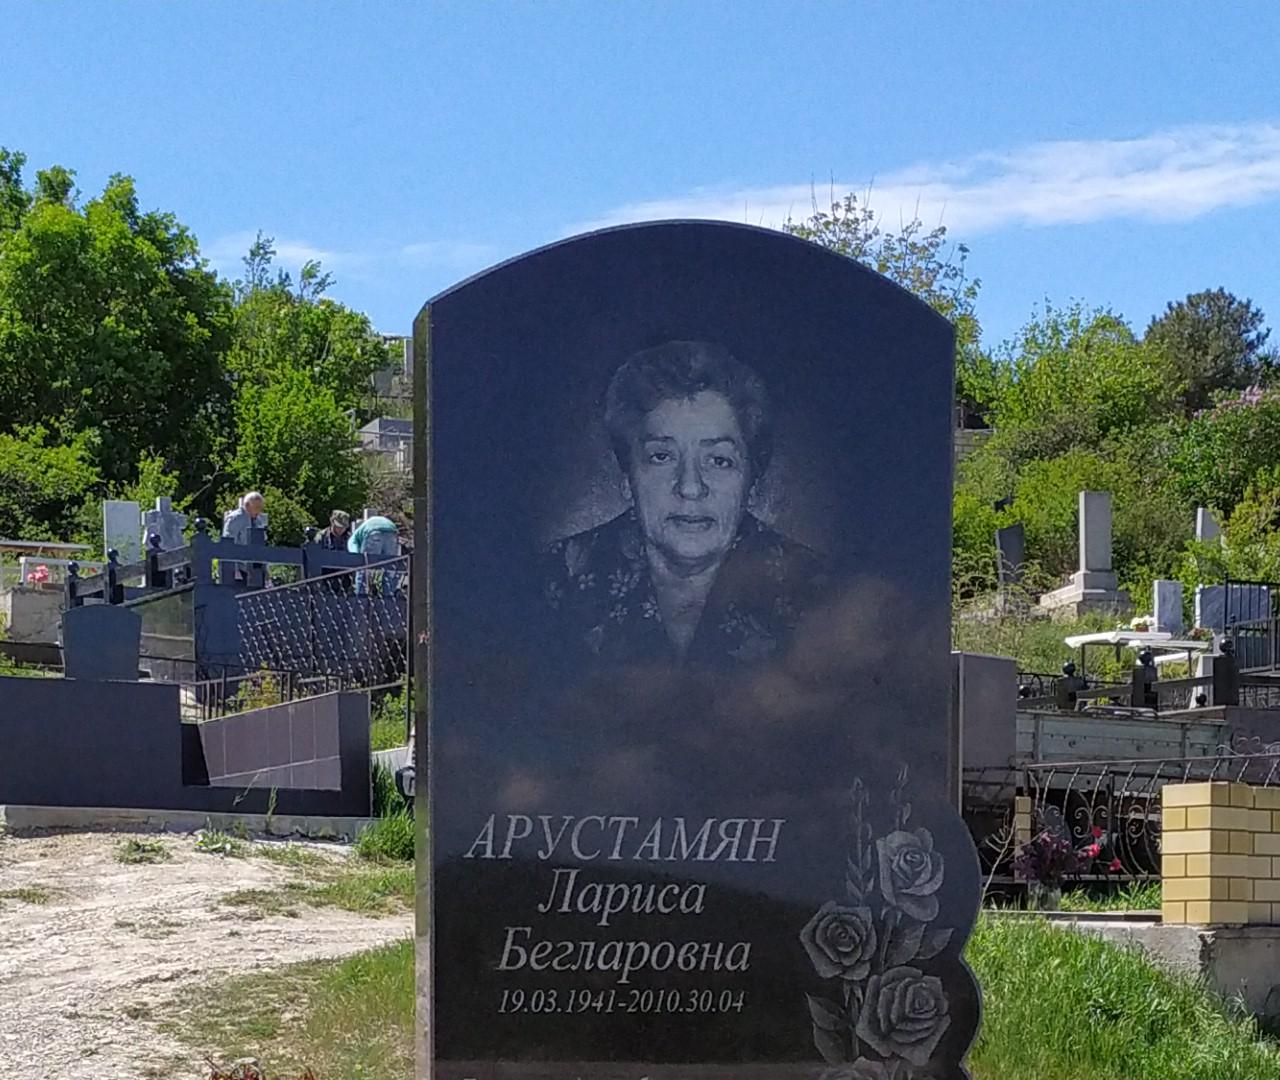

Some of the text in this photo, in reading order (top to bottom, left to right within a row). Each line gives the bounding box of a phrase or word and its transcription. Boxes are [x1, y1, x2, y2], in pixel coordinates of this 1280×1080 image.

[463, 813, 786, 862] АРУСТАМЯН
[538, 868, 707, 927] Лариса
[495, 926, 753, 984] Бегларовна
[497, 988, 747, 1014] 19.03.1941-2010.30.04
